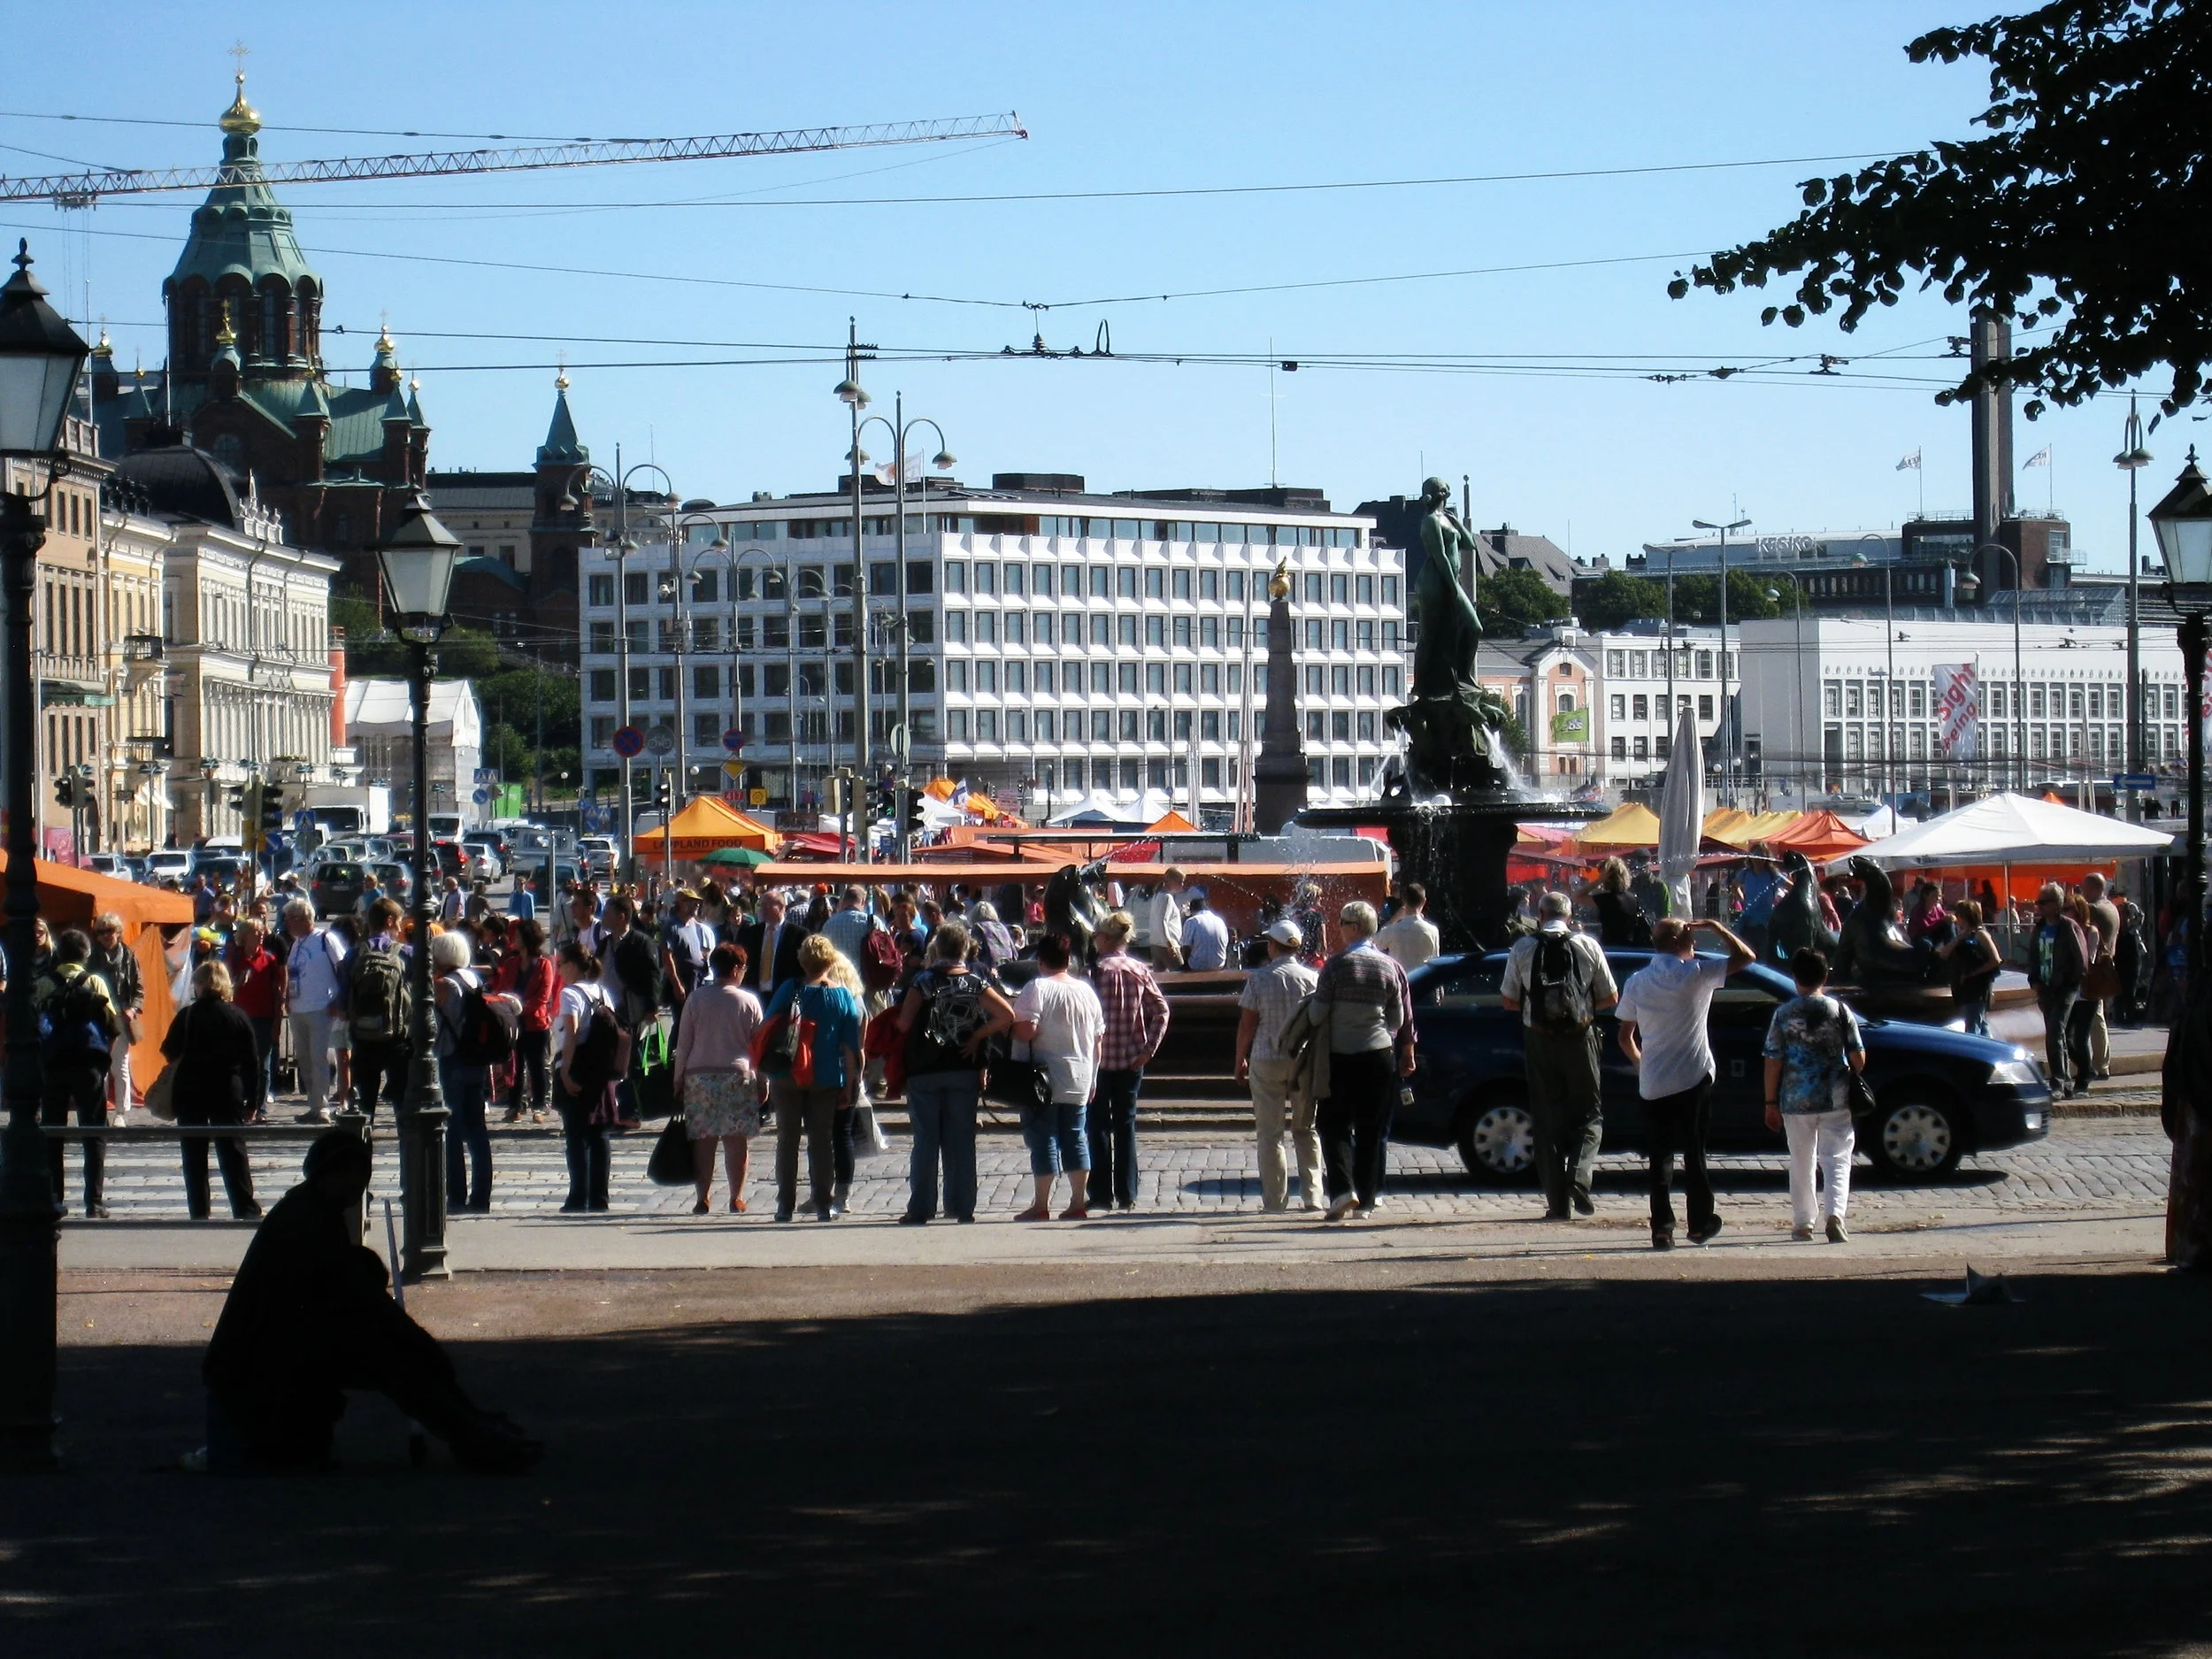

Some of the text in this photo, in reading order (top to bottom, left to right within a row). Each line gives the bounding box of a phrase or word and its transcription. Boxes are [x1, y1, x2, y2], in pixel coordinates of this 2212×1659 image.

[1755, 535, 1814, 553] KESKO
[653, 838, 742, 849] LAPLAND FOOD
